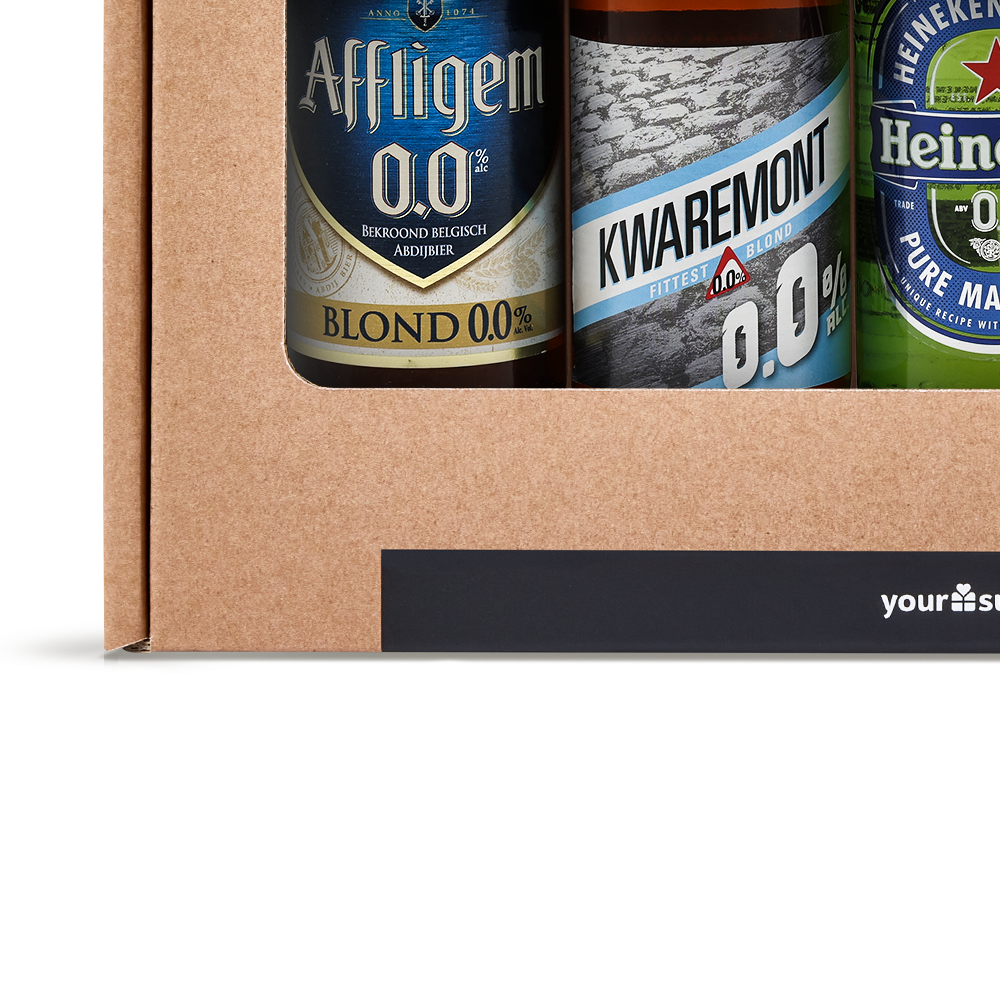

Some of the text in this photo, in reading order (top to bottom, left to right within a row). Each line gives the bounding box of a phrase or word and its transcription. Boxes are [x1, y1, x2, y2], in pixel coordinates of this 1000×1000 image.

[368, 7, 475, 17] ANNO 1074
[299, 36, 544, 136] Affligem
[950, 92, 970, 102] EST.
[475, 164, 489, 173] alc
[600, 117, 829, 289] KWAREMONT
[894, 199, 915, 210] TRADE
[362, 224, 486, 239] BEKROOND BELGISCH
[650, 223, 793, 298] FITTEST BLOND
[899, 231, 953, 298] PURE
[712, 269, 747, 295] 0.0%
[900, 276, 931, 311] UNIQUE
[935, 307, 973, 328] RECIPE
[322, 305, 460, 344] BLOND
[881, 593, 949, 619] your
